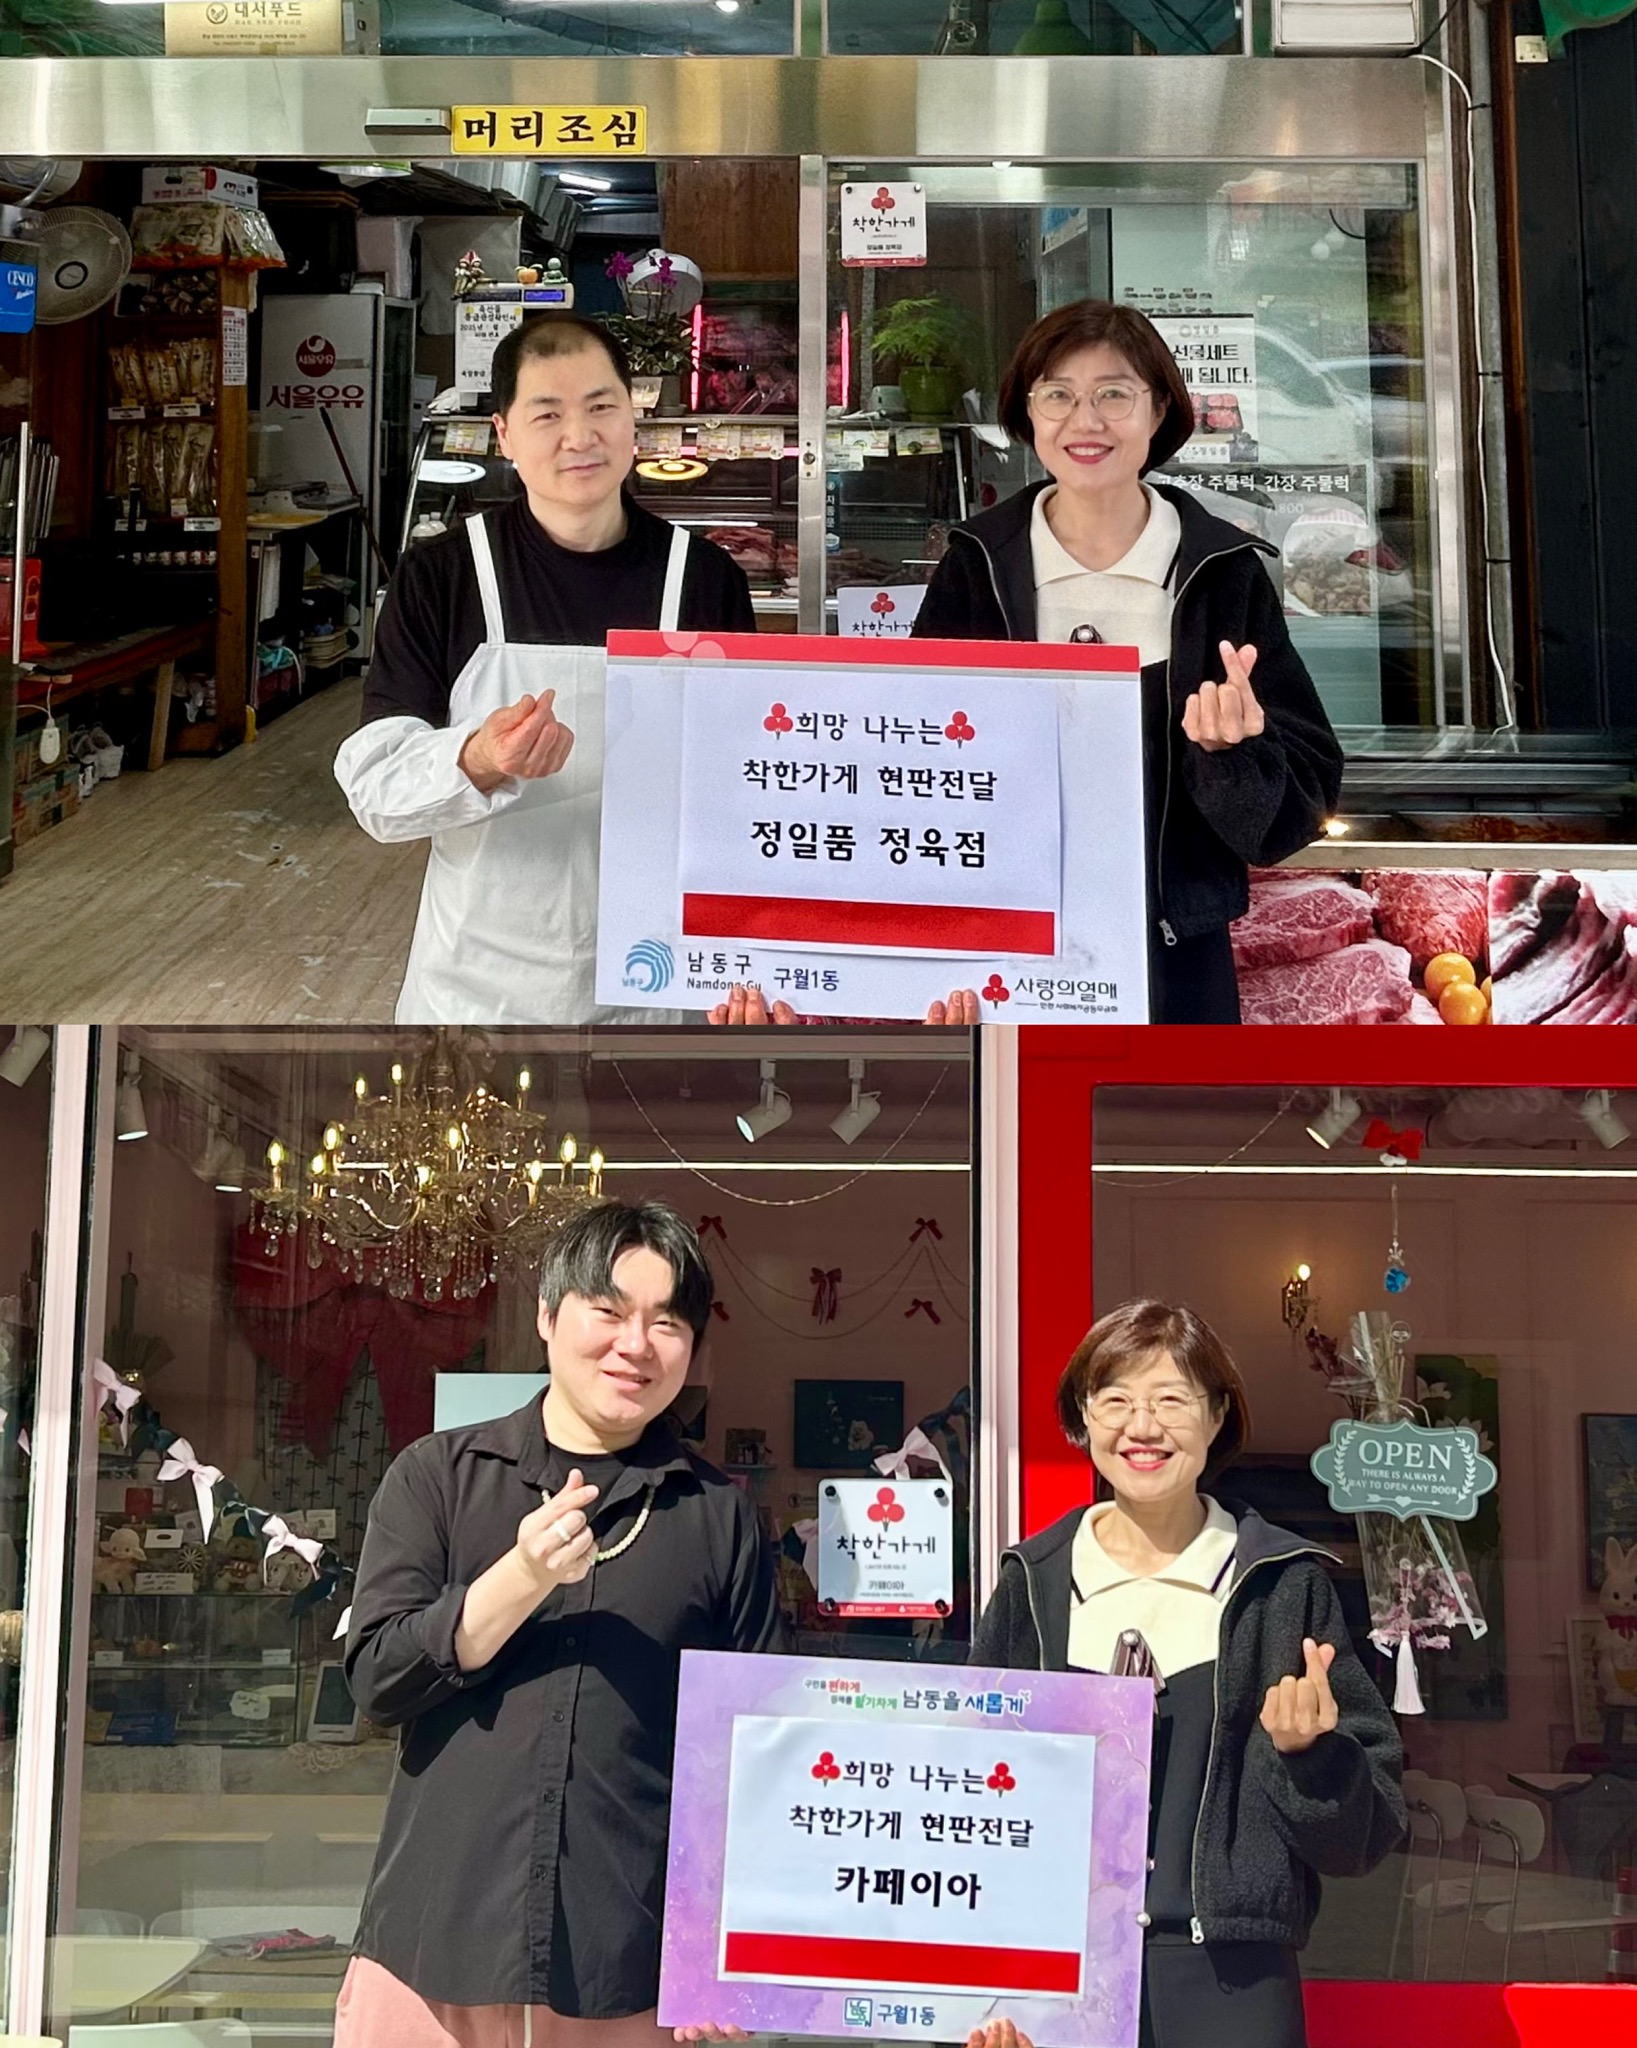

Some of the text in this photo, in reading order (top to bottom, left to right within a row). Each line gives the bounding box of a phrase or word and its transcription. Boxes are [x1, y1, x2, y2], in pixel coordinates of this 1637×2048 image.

[234, 1, 303, 18] 대서푸드
[463, 110, 638, 149] 머리조심
[853, 216, 915, 233] 착한가게
[1173, 344, 1239, 361] 선물세트
[1199, 366, 1252, 384] 됩니다.
[266, 384, 365, 409] 서울우유
[1208, 475, 1255, 492] 주물럭
[1264, 475, 1297, 493] 간장
[1301, 475, 1350, 493] 주물럭
[795, 712, 943, 746] 희망 나누는
[742, 759, 997, 801] 착한가게 현판전달
[750, 821, 985, 868] 정일품 정육점
[688, 951, 752, 975] 남동구
[774, 966, 839, 992] 구월1동
[1015, 978, 1117, 1002] 사랑의열매
[1358, 1439, 1453, 1470] OPEN
[1361, 1469, 1389, 1478] THERE
[1404, 1472, 1437, 1482] ALWAYS
[1370, 1481, 1381, 1489] TO
[1384, 1482, 1407, 1491] OPEN
[1410, 1485, 1429, 1493] ANY
[1431, 1486, 1457, 1495] DOOR
[837, 1534, 935, 1560] 착한가게
[903, 1690, 960, 1711] 남동을
[965, 1693, 1023, 1714] 새롭게
[843, 1761, 985, 1794] 희망 나누는
[789, 1805, 1034, 1848] 착한가게 현판전달
[835, 1867, 982, 1910] 카페이아
[877, 2003, 935, 2026] 구월1동
